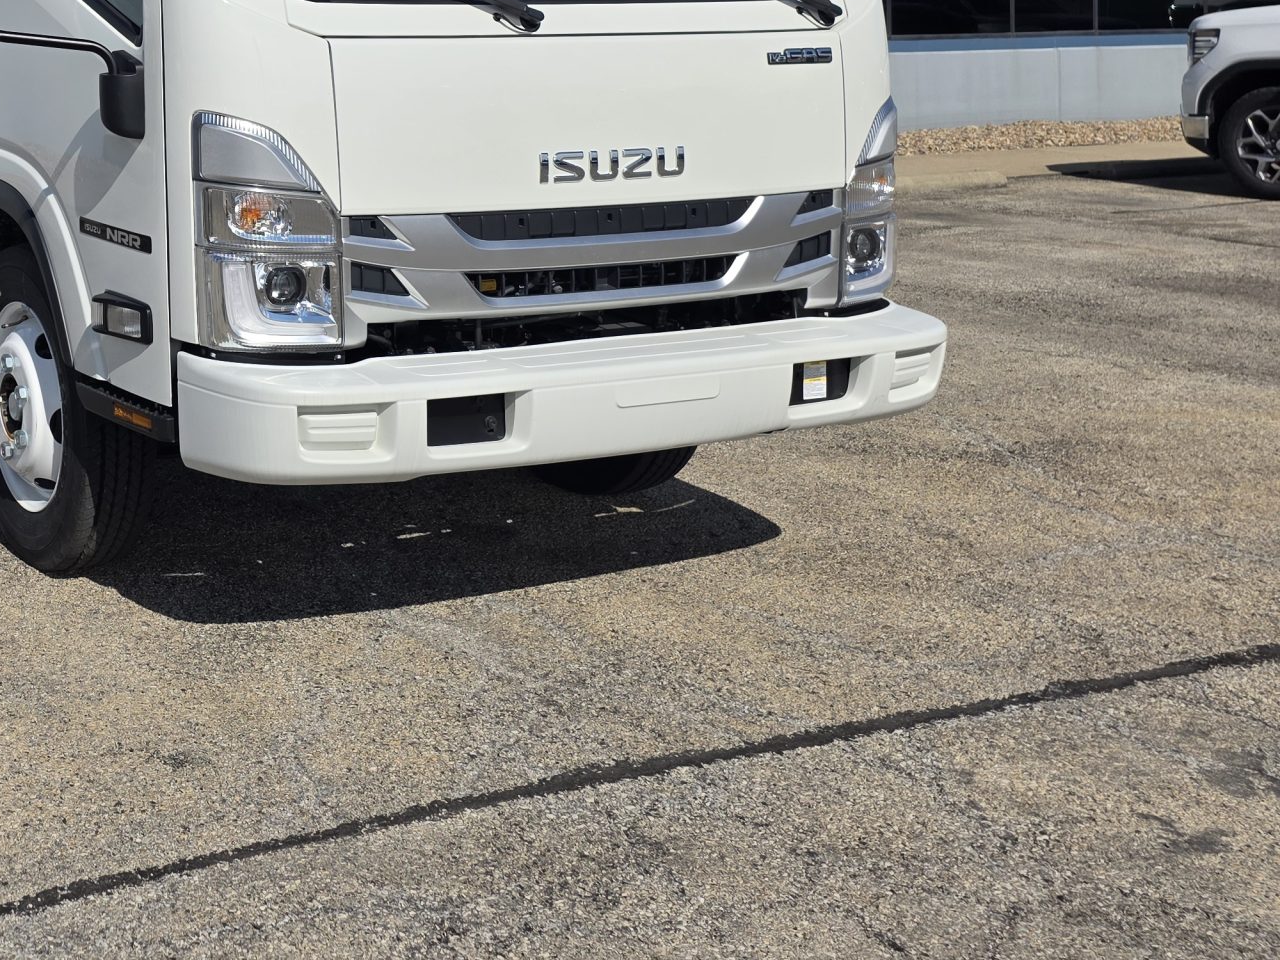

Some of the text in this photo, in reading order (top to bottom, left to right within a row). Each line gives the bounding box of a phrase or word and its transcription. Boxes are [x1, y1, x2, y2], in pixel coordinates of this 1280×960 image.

[539, 146, 685, 184] ISUZU
[84, 223, 141, 249] ISUZU NRR
